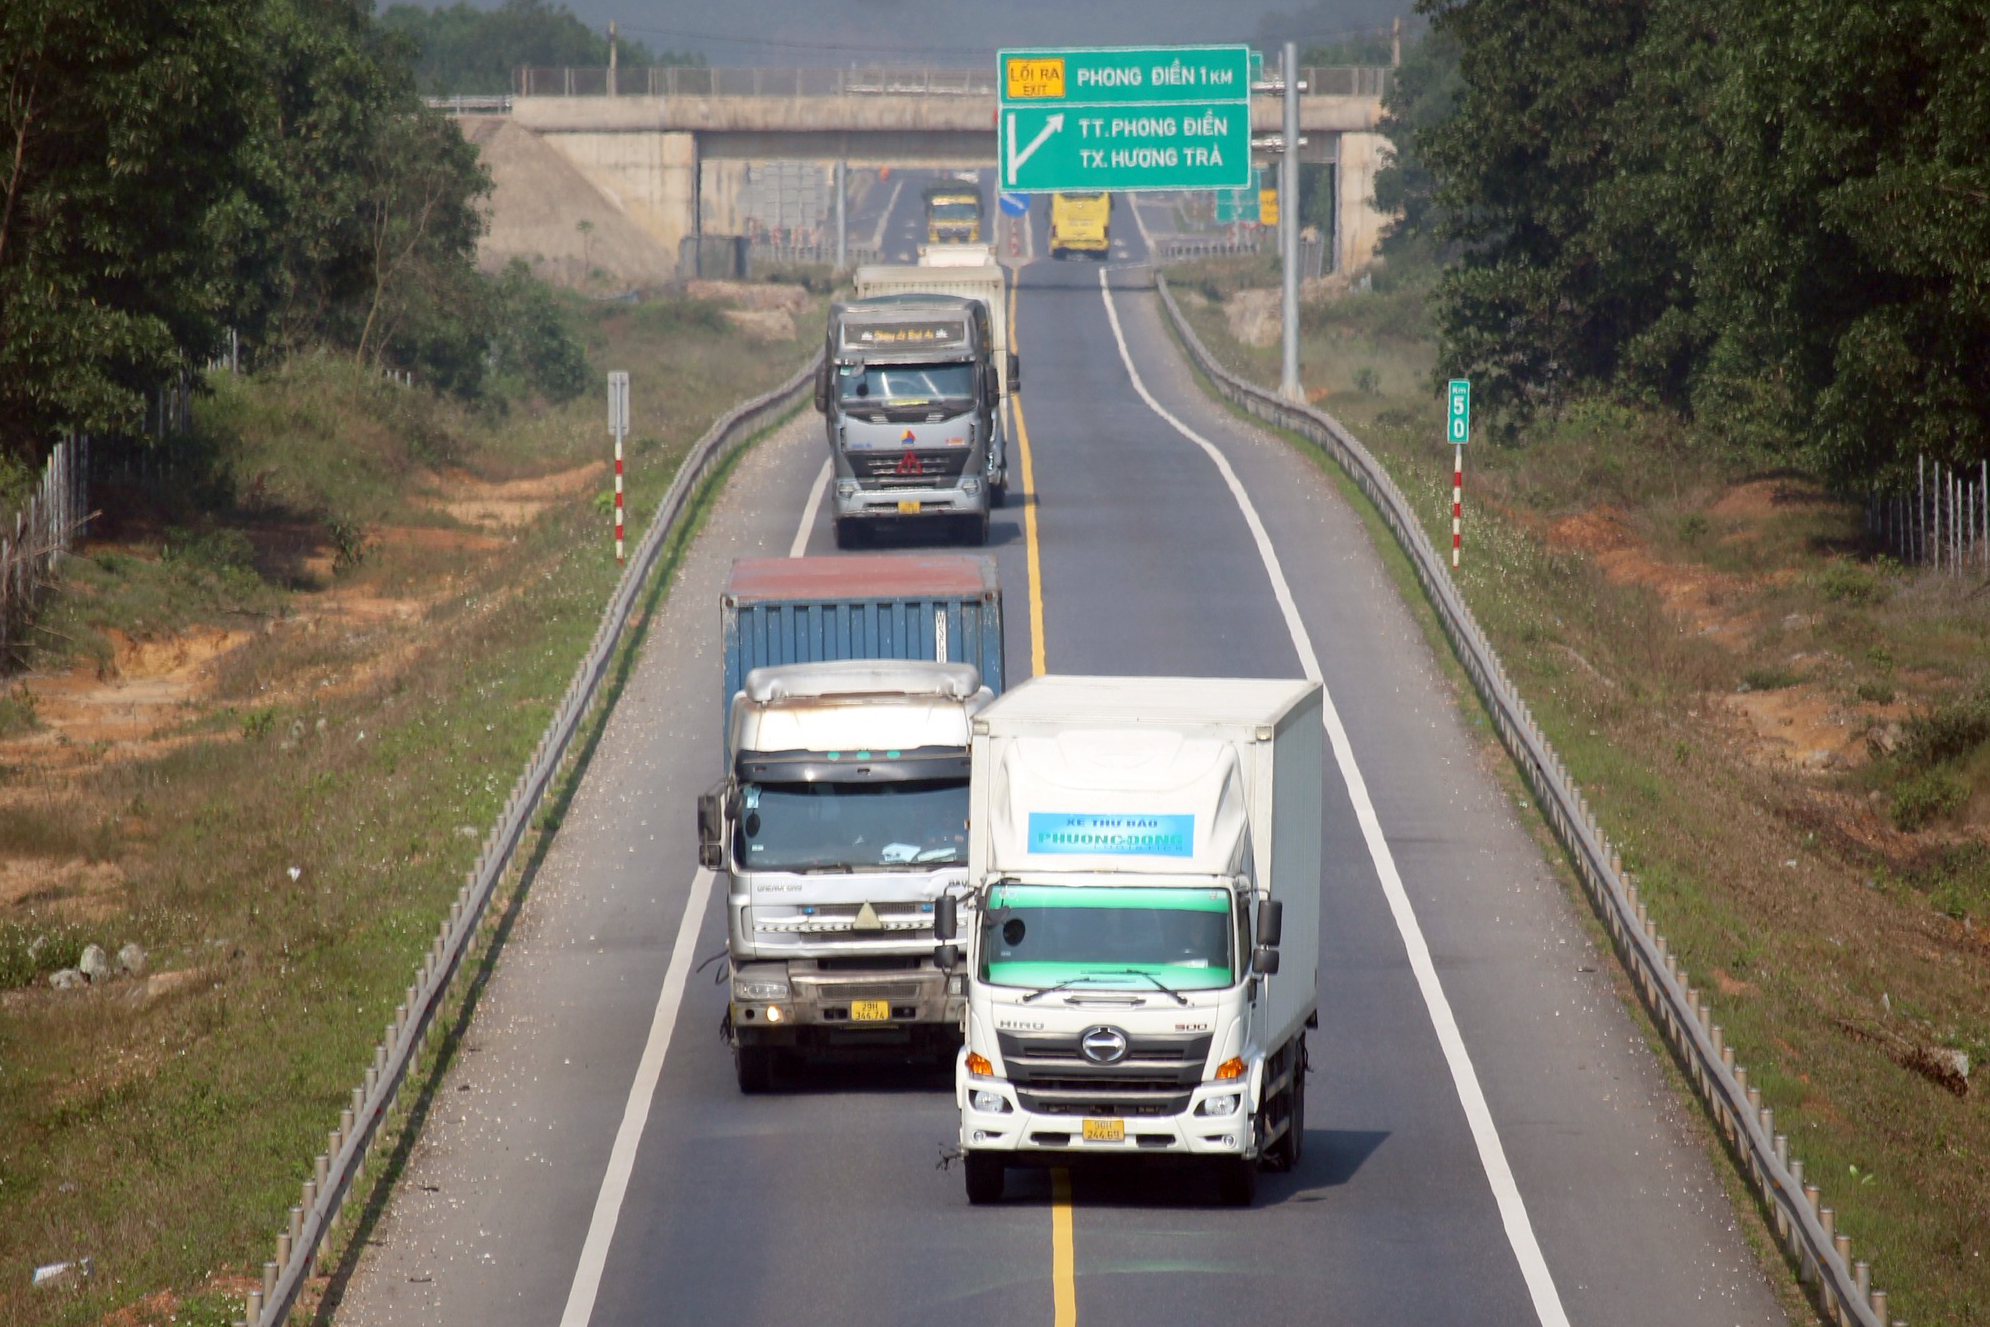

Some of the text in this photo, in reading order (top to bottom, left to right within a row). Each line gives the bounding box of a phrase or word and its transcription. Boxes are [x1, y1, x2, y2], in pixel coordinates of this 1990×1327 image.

[1041, 68, 1060, 80] RA
[1077, 67, 1142, 87] PHONG
[1023, 85, 1047, 96] EXIT
[1066, 819, 1085, 827] XE
[999, 1020, 1208, 1031] HINO 500
